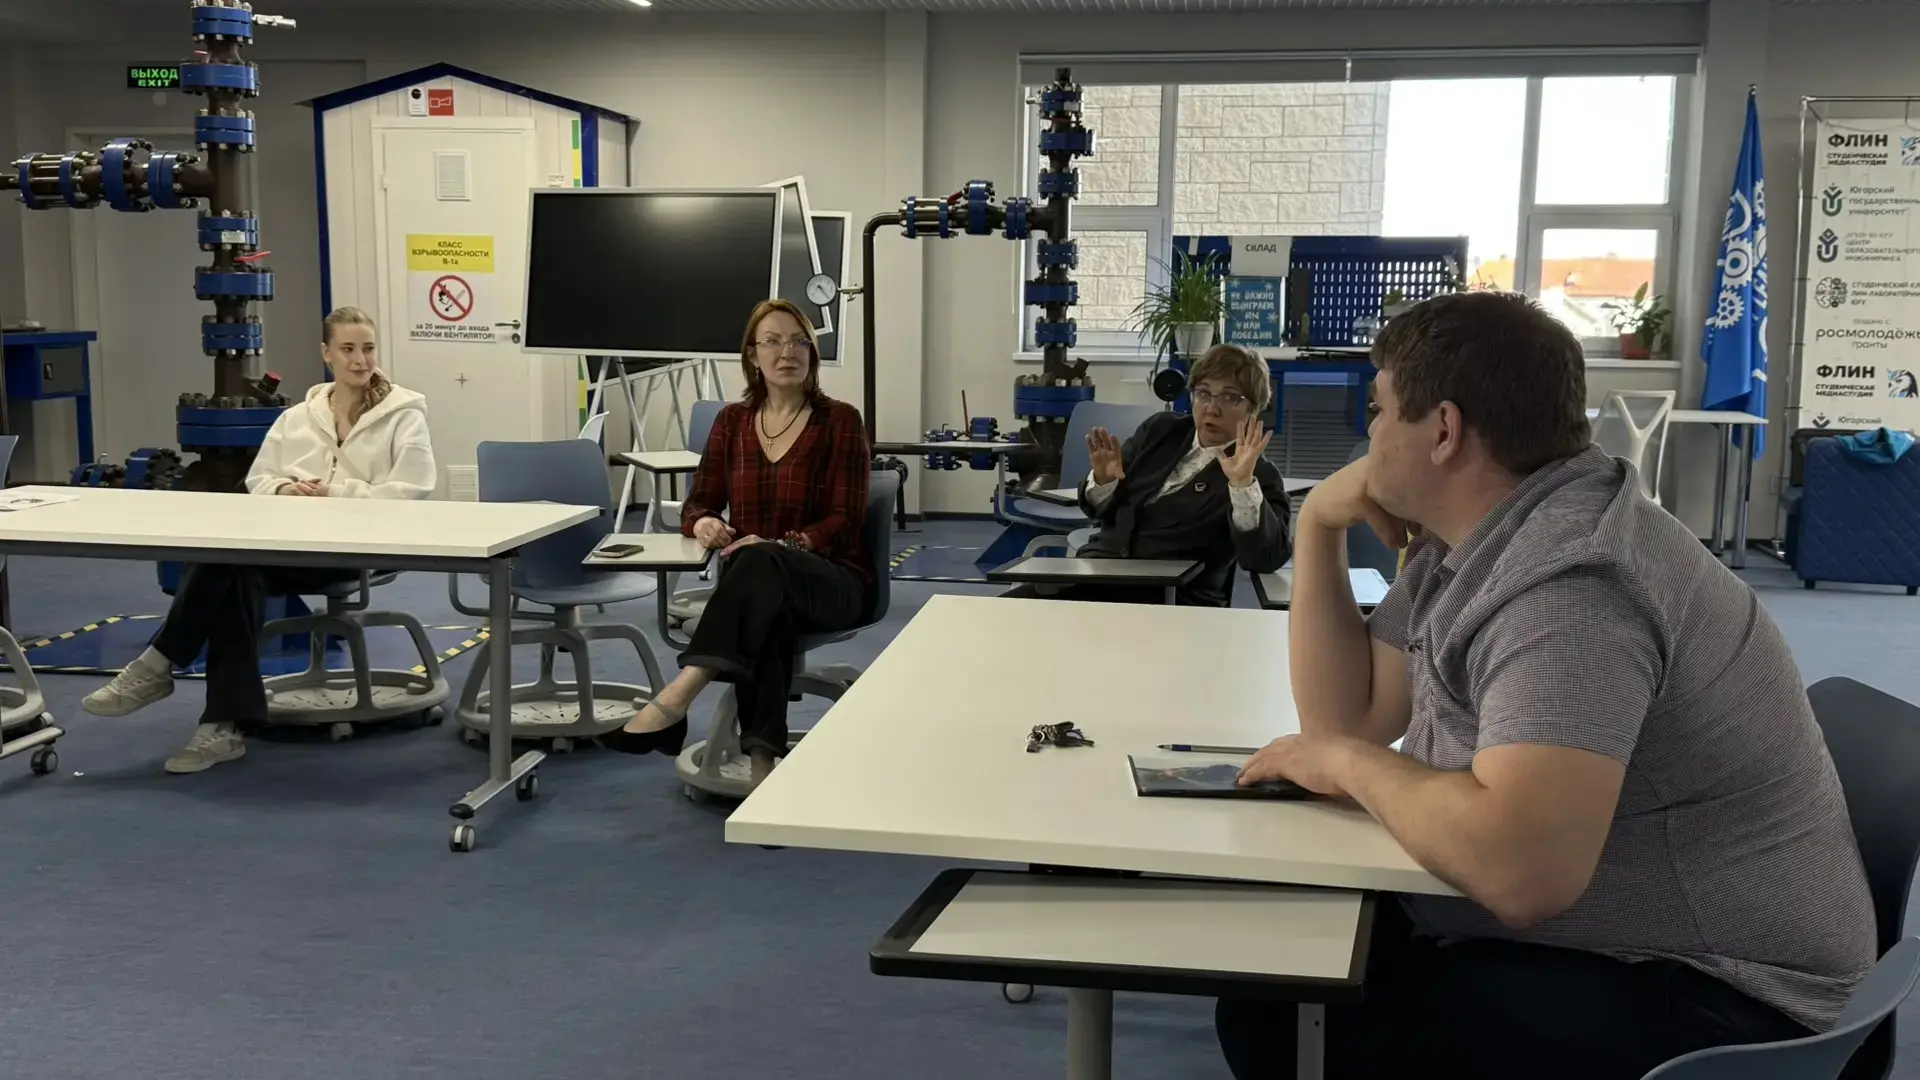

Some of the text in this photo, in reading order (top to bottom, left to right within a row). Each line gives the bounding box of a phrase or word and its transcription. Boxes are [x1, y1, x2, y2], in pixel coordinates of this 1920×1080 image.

[131, 68, 178, 79] ВЫХОД
[138, 79, 169, 87] EXIT
[1828, 133, 1888, 148] ФЛИН
[1849, 186, 1895, 195] Югорский
[1848, 209, 1906, 217] университет
[437, 241, 463, 249] КЛАСС
[1245, 244, 1277, 253] СКЛАД
[412, 248, 489, 258] ВЗРЫВООПАСНОСТИ
[1244, 291, 1275, 301] ВАЖНО
[1231, 301, 1275, 310] ВЫИГРАЕМ
[434, 324, 456, 332] минут
[410, 330, 442, 338] ВКЛЮЧИ
[1231, 331, 1272, 340] ПОБЕДИМ
[1852, 341, 1887, 349] гранты
[1816, 364, 1875, 379] ФЛИН
[1815, 383, 1875, 391] СТУДЕНЧЕСКАЯ
[1815, 390, 1873, 398] МЕДИАСТУДИЯ
[1838, 416, 1882, 425] Югорский
